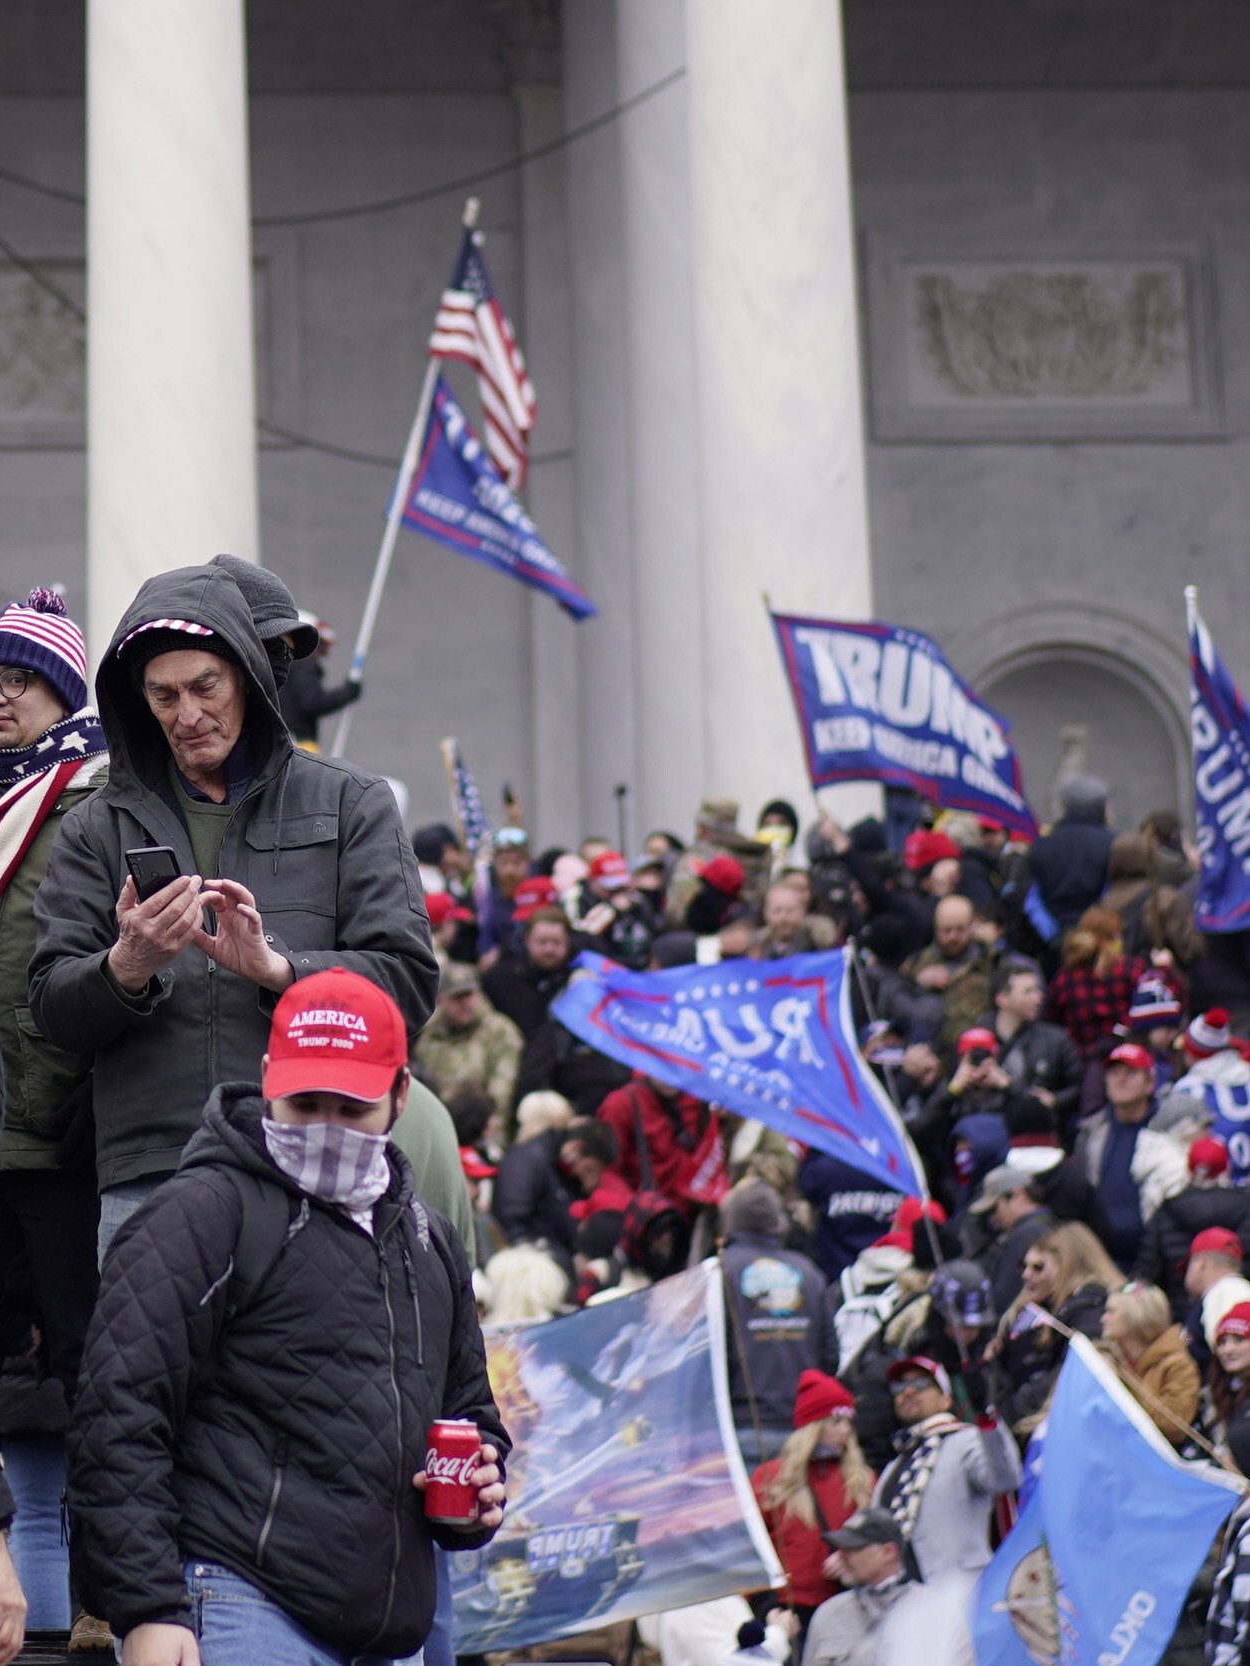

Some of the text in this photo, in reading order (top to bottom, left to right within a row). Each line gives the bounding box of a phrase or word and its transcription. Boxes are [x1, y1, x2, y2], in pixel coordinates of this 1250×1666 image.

[795, 626, 1010, 770] TRUMP
[813, 715, 872, 754] KEEP
[289, 1009, 367, 1032] AMERICA
[297, 1036, 330, 1048] TRUMP
